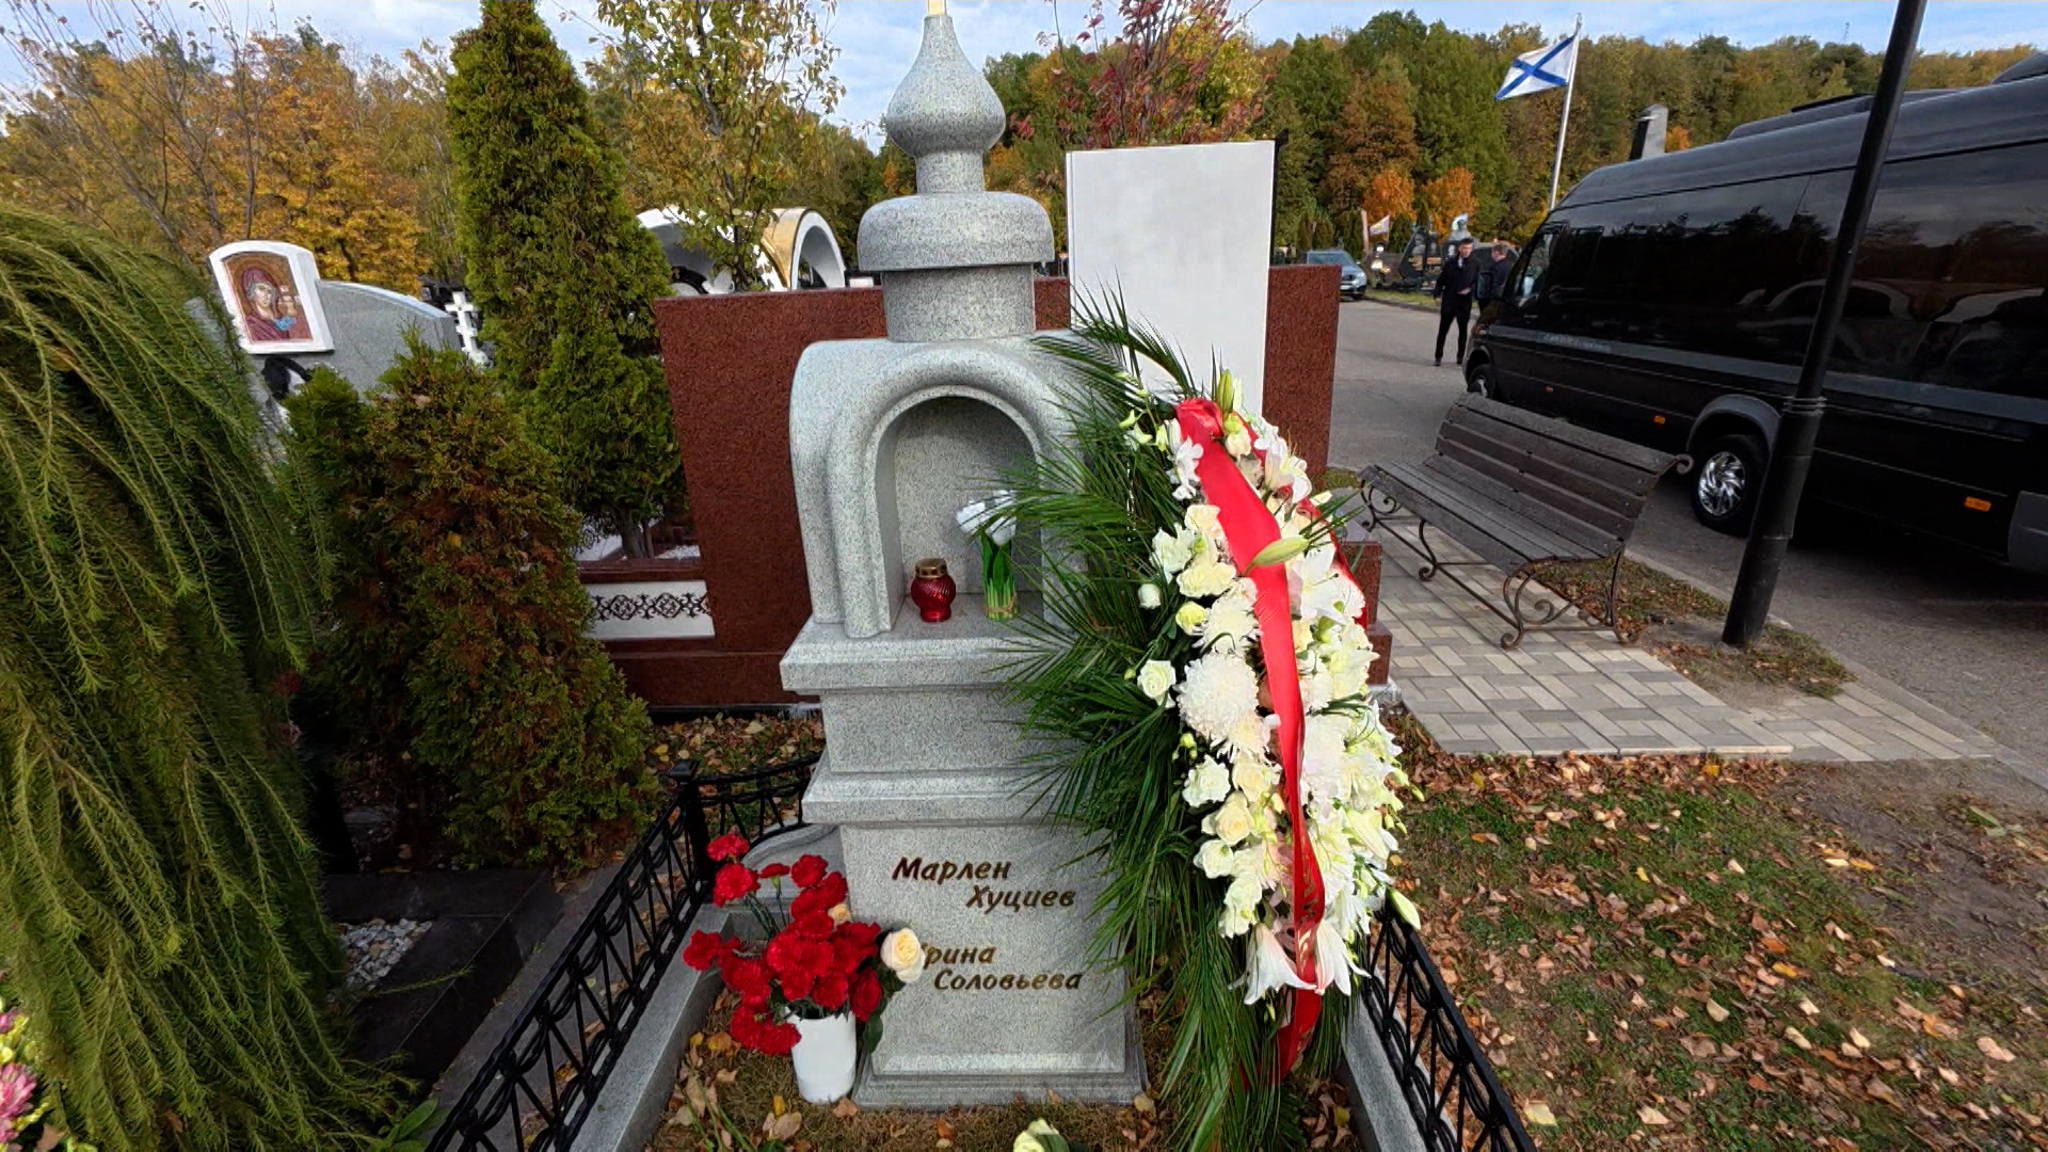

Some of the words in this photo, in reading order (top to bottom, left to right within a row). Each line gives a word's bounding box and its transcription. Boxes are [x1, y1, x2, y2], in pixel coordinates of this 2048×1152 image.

[892, 857, 1011, 884] Марлен
[966, 886, 1075, 914] Хуциев
[922, 943, 996, 969] рина
[934, 970, 1083, 990] Соловьева
